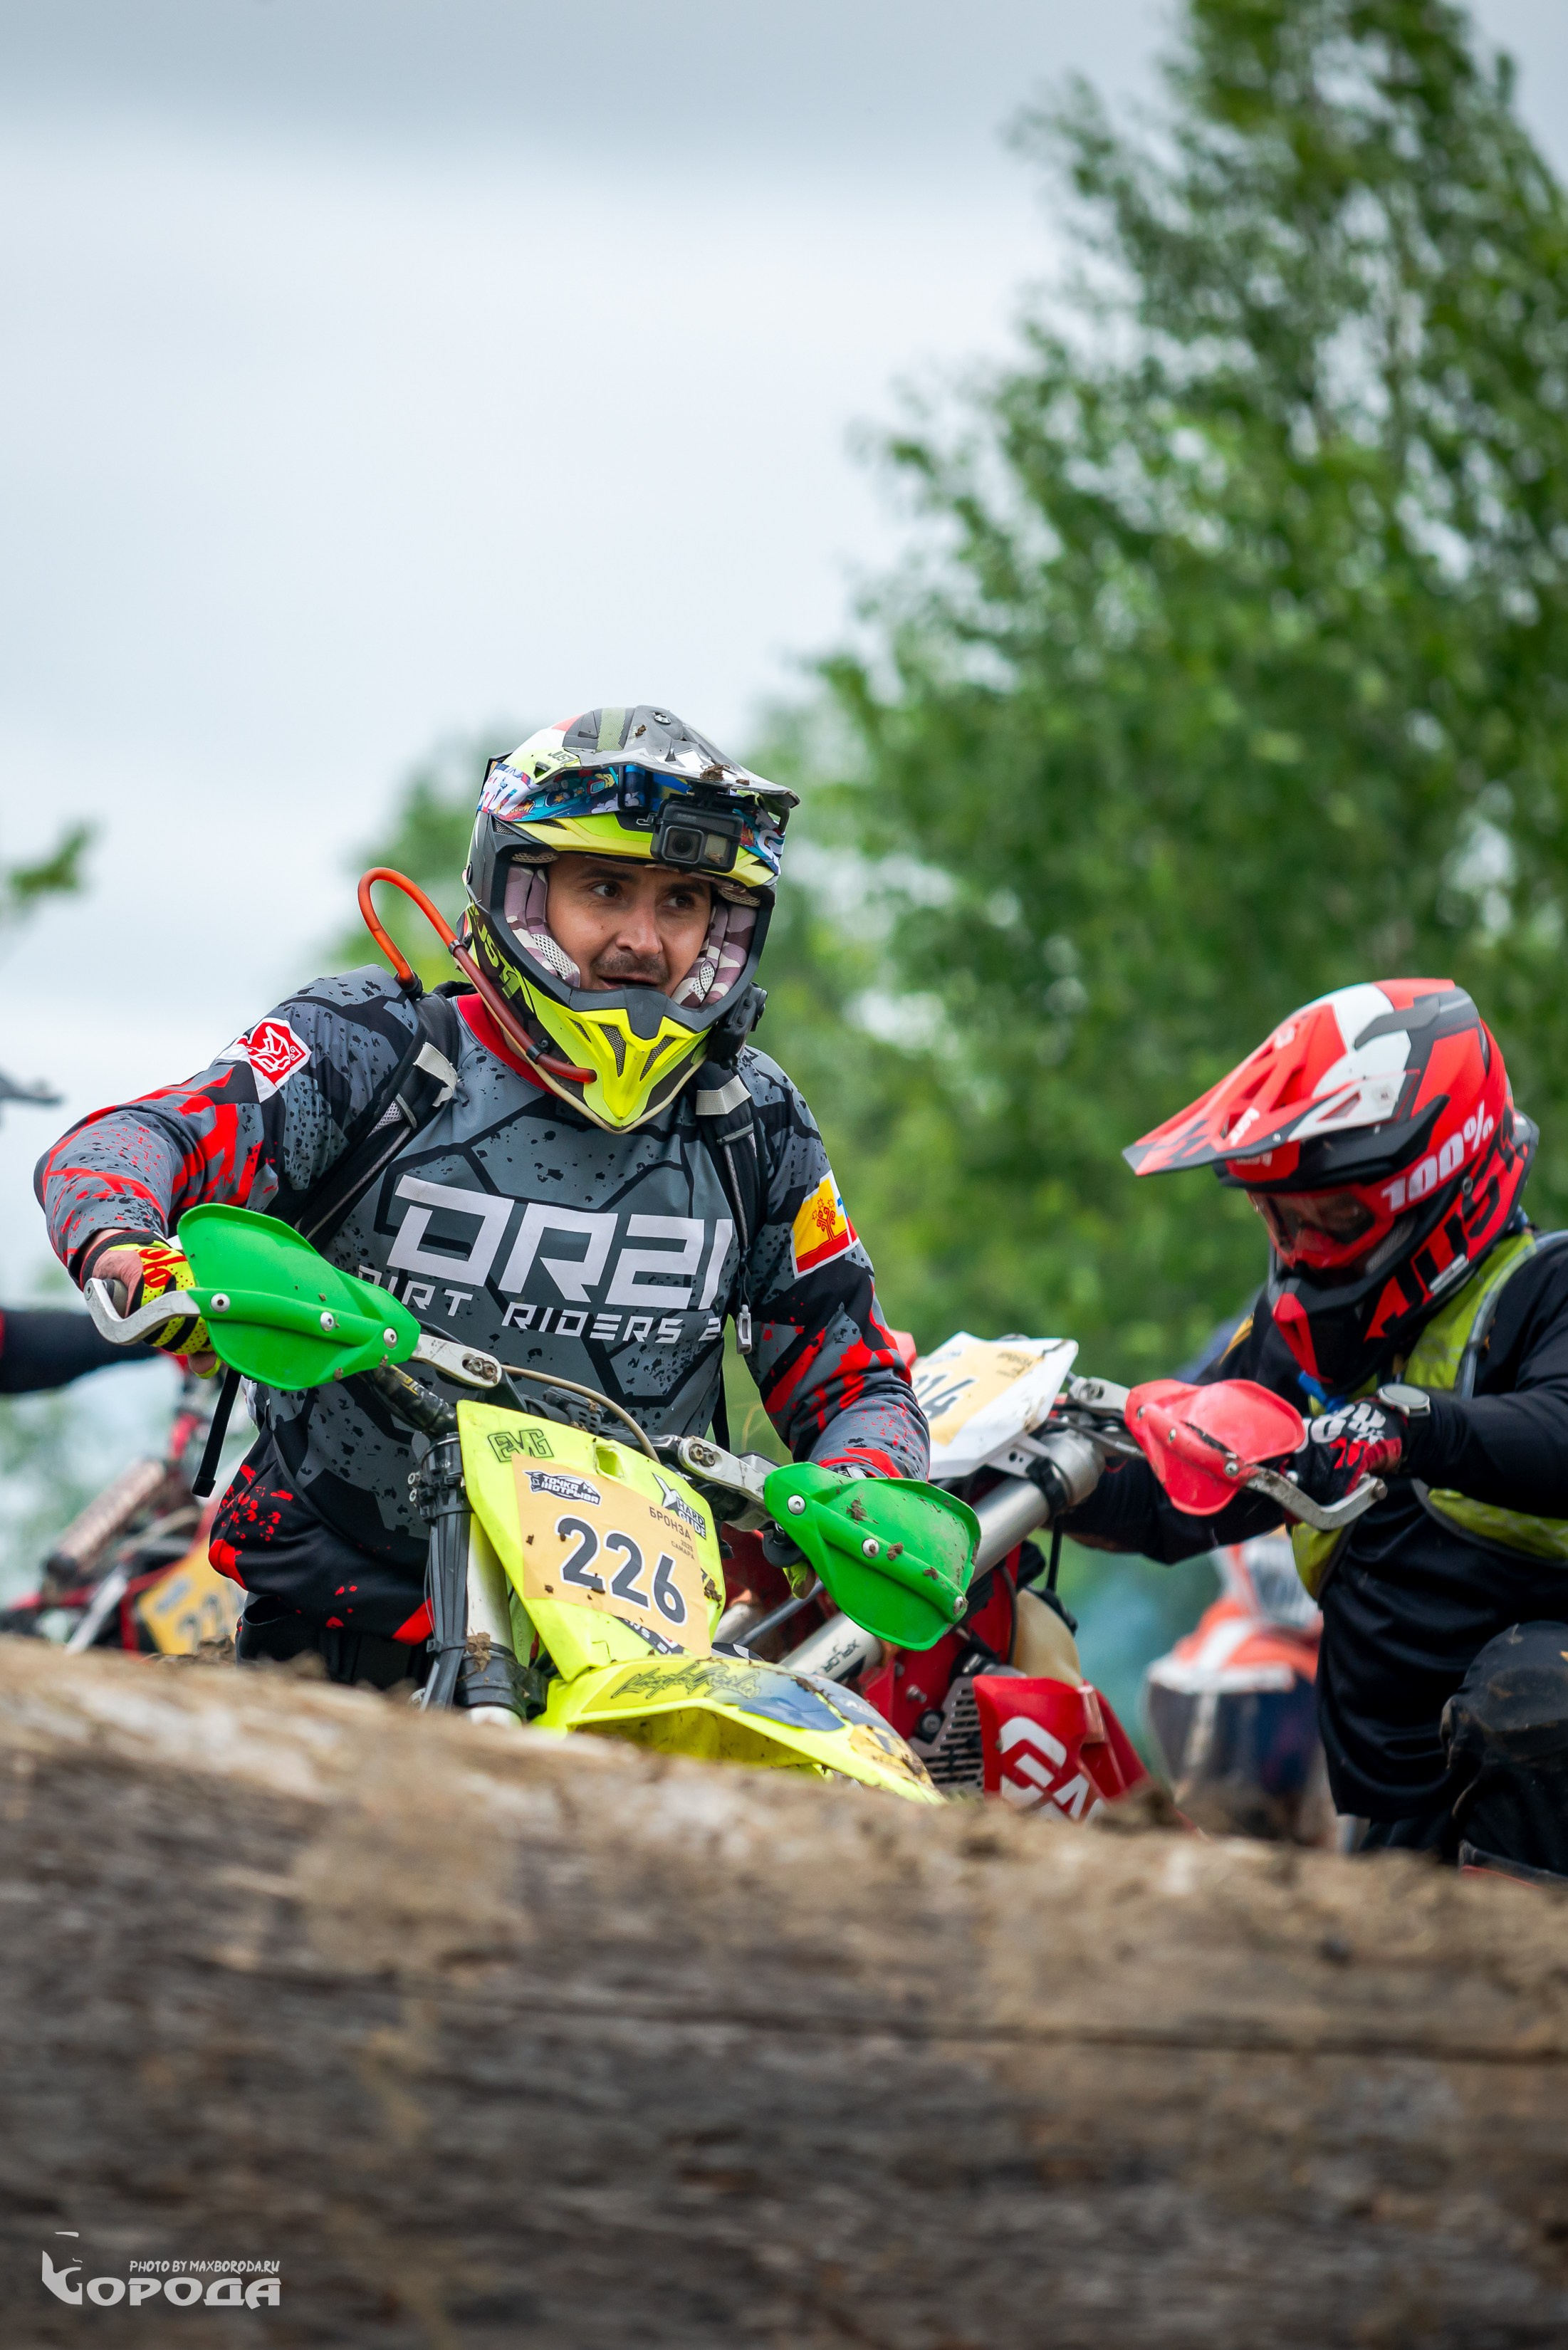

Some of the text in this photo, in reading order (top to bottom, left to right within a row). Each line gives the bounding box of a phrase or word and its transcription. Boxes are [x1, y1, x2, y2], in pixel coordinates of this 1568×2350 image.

[1381, 1100, 1494, 1211] 100%
[502, 1302, 684, 1344] RIDERS
[698, 1317, 723, 1342] 2
[542, 1475, 580, 1491] ТОЧКА
[649, 1506, 691, 1541] БРОНЗА
[676, 1498, 705, 1526] HARD
[556, 1516, 686, 1624] 226
